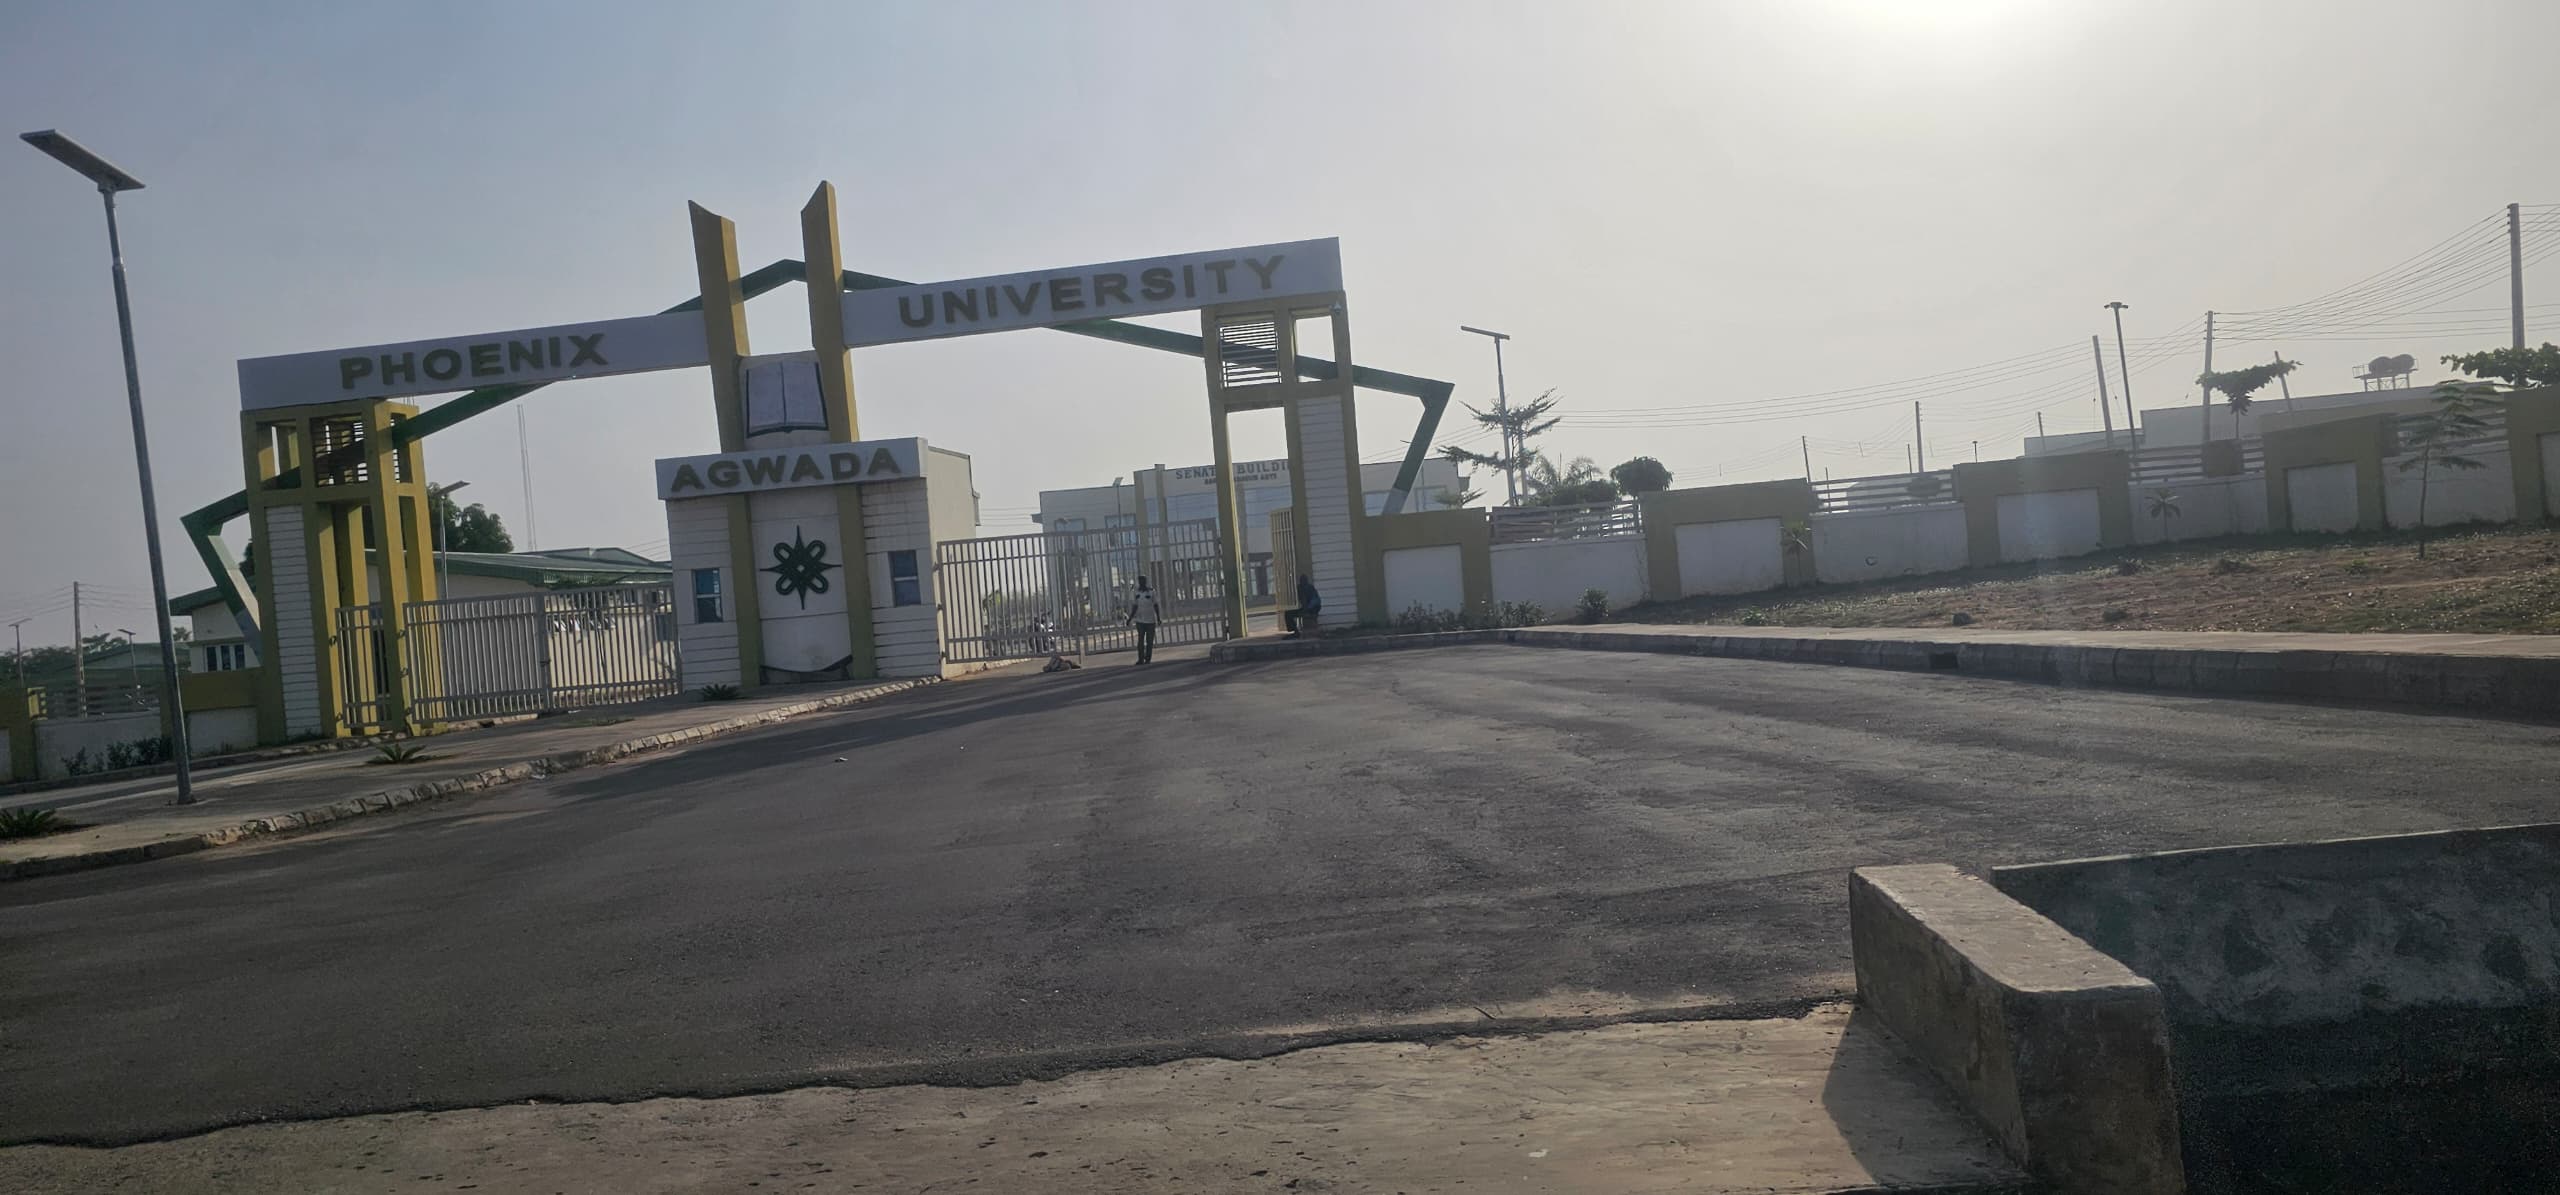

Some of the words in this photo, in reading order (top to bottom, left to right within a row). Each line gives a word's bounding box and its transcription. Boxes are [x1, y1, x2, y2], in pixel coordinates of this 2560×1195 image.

[339, 334, 608, 389] PHOENIX
[898, 255, 1286, 328] UNIVERSITY
[671, 448, 901, 492] AGWADA
[1175, 466, 1217, 480] SENAT
[1237, 460, 1290, 475] BUILDI
